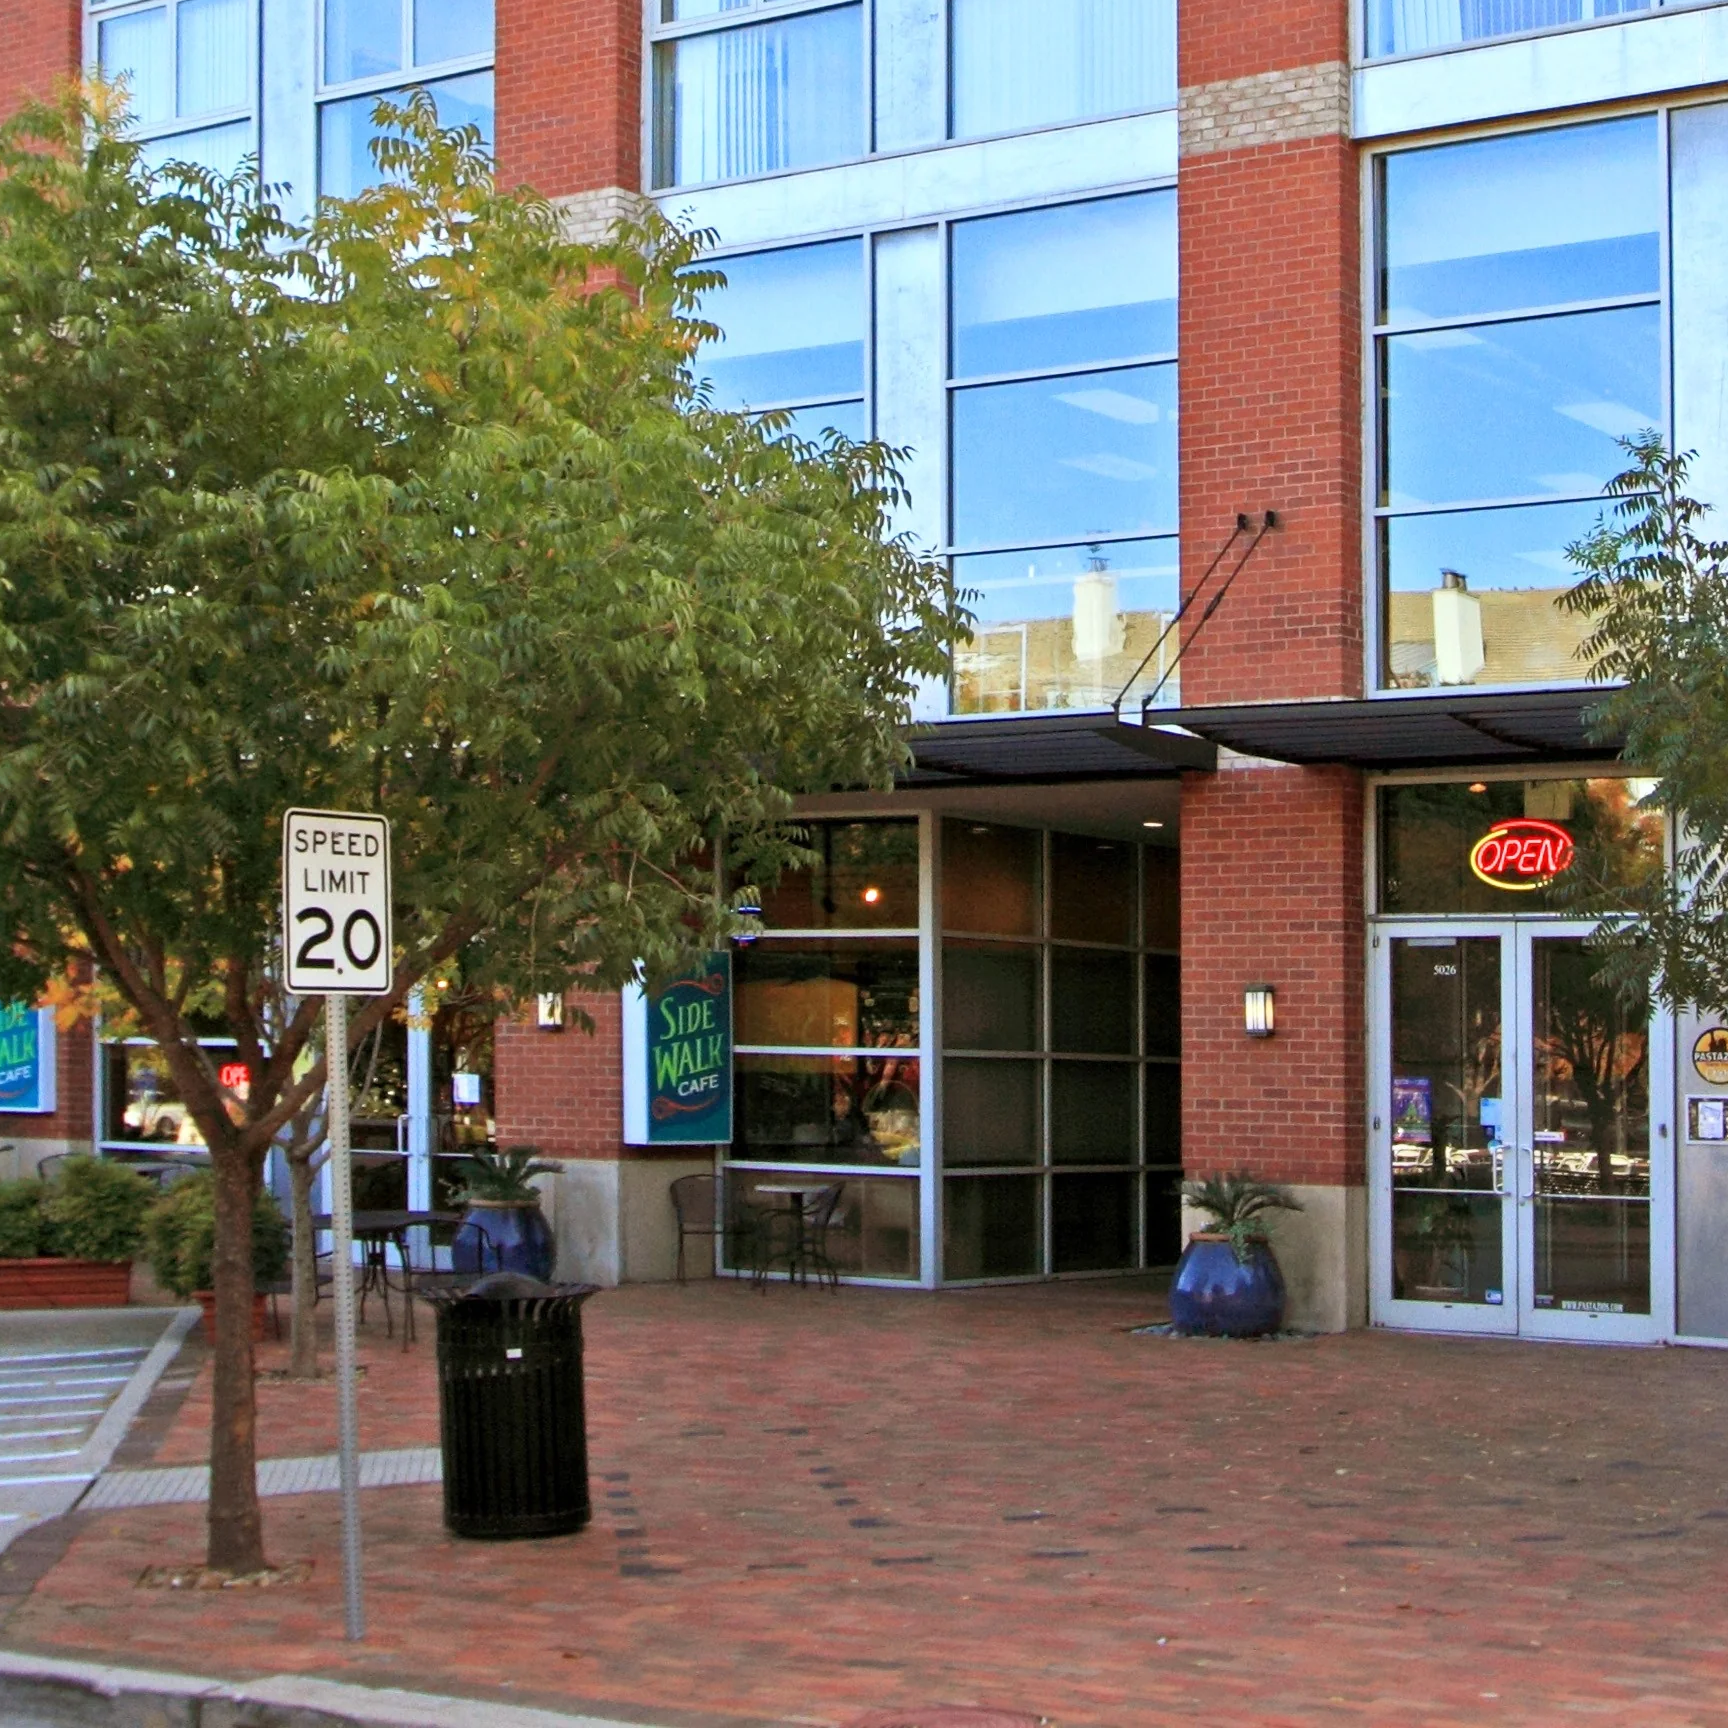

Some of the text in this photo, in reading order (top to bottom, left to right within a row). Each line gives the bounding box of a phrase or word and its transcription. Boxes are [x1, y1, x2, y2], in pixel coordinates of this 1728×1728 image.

[294, 829, 379, 857] SPEED
[1477, 839, 1564, 872] OPEN
[304, 868, 370, 894] LIMIT
[295, 906, 382, 970] 20
[1433, 964, 1457, 976] 5026
[659, 997, 715, 1040] SIDE
[652, 1033, 724, 1091] WALK
[678, 1074, 720, 1097] CAFE
